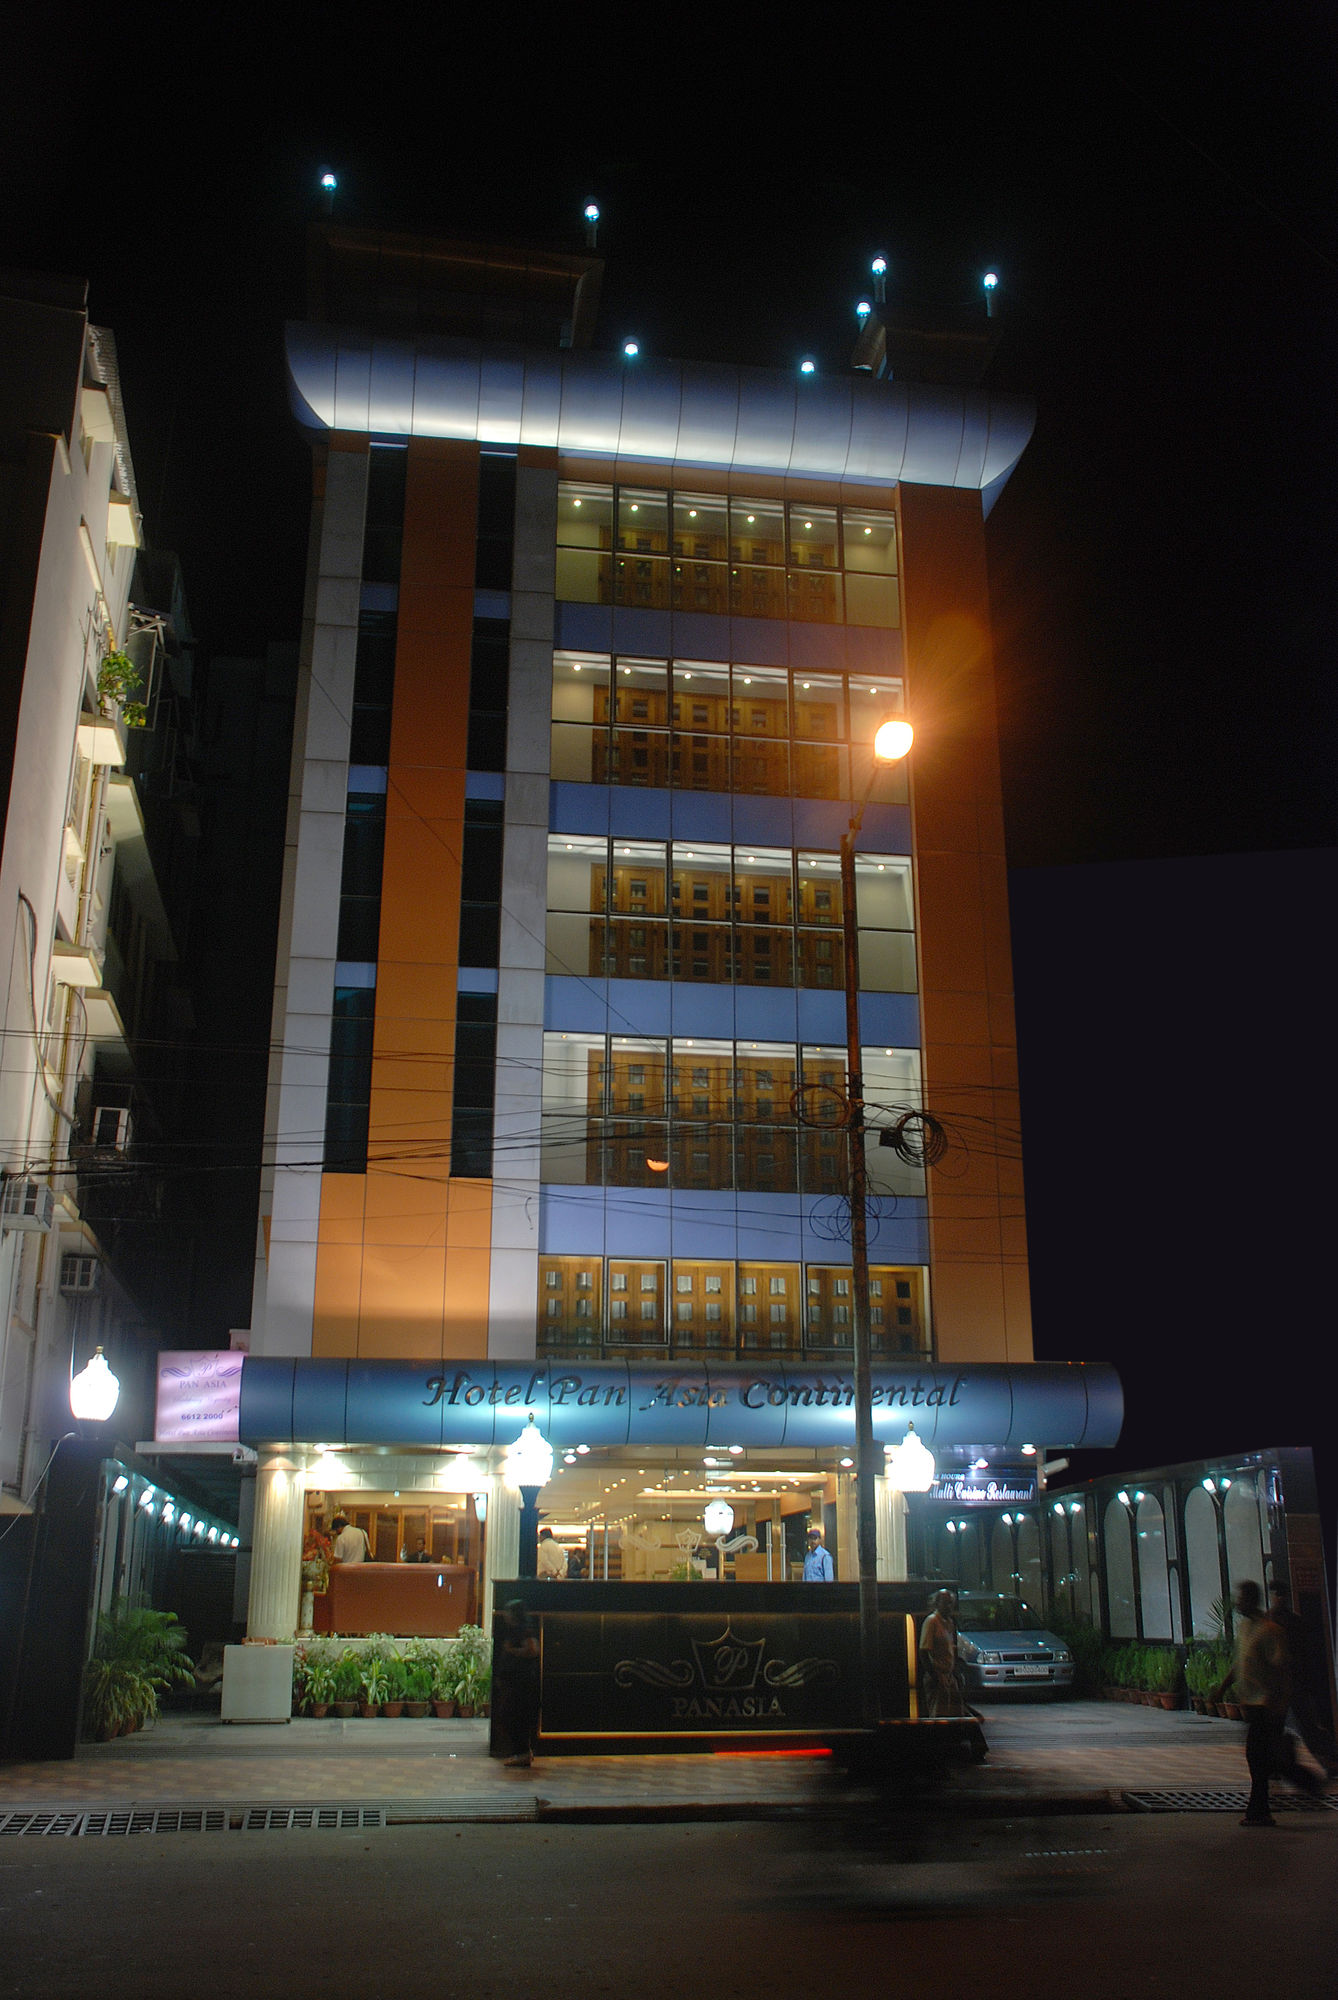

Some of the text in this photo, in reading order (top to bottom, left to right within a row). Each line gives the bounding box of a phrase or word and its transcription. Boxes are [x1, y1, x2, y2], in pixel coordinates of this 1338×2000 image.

[179, 1380, 226, 1389] PAN ASIA
[422, 1369, 547, 1406] Hotel
[548, 1375, 627, 1406] Pan
[639, 1376, 728, 1411] Asia
[987, 1481, 1034, 1500] Restaurant
[671, 1696, 786, 1718] PANASIA
